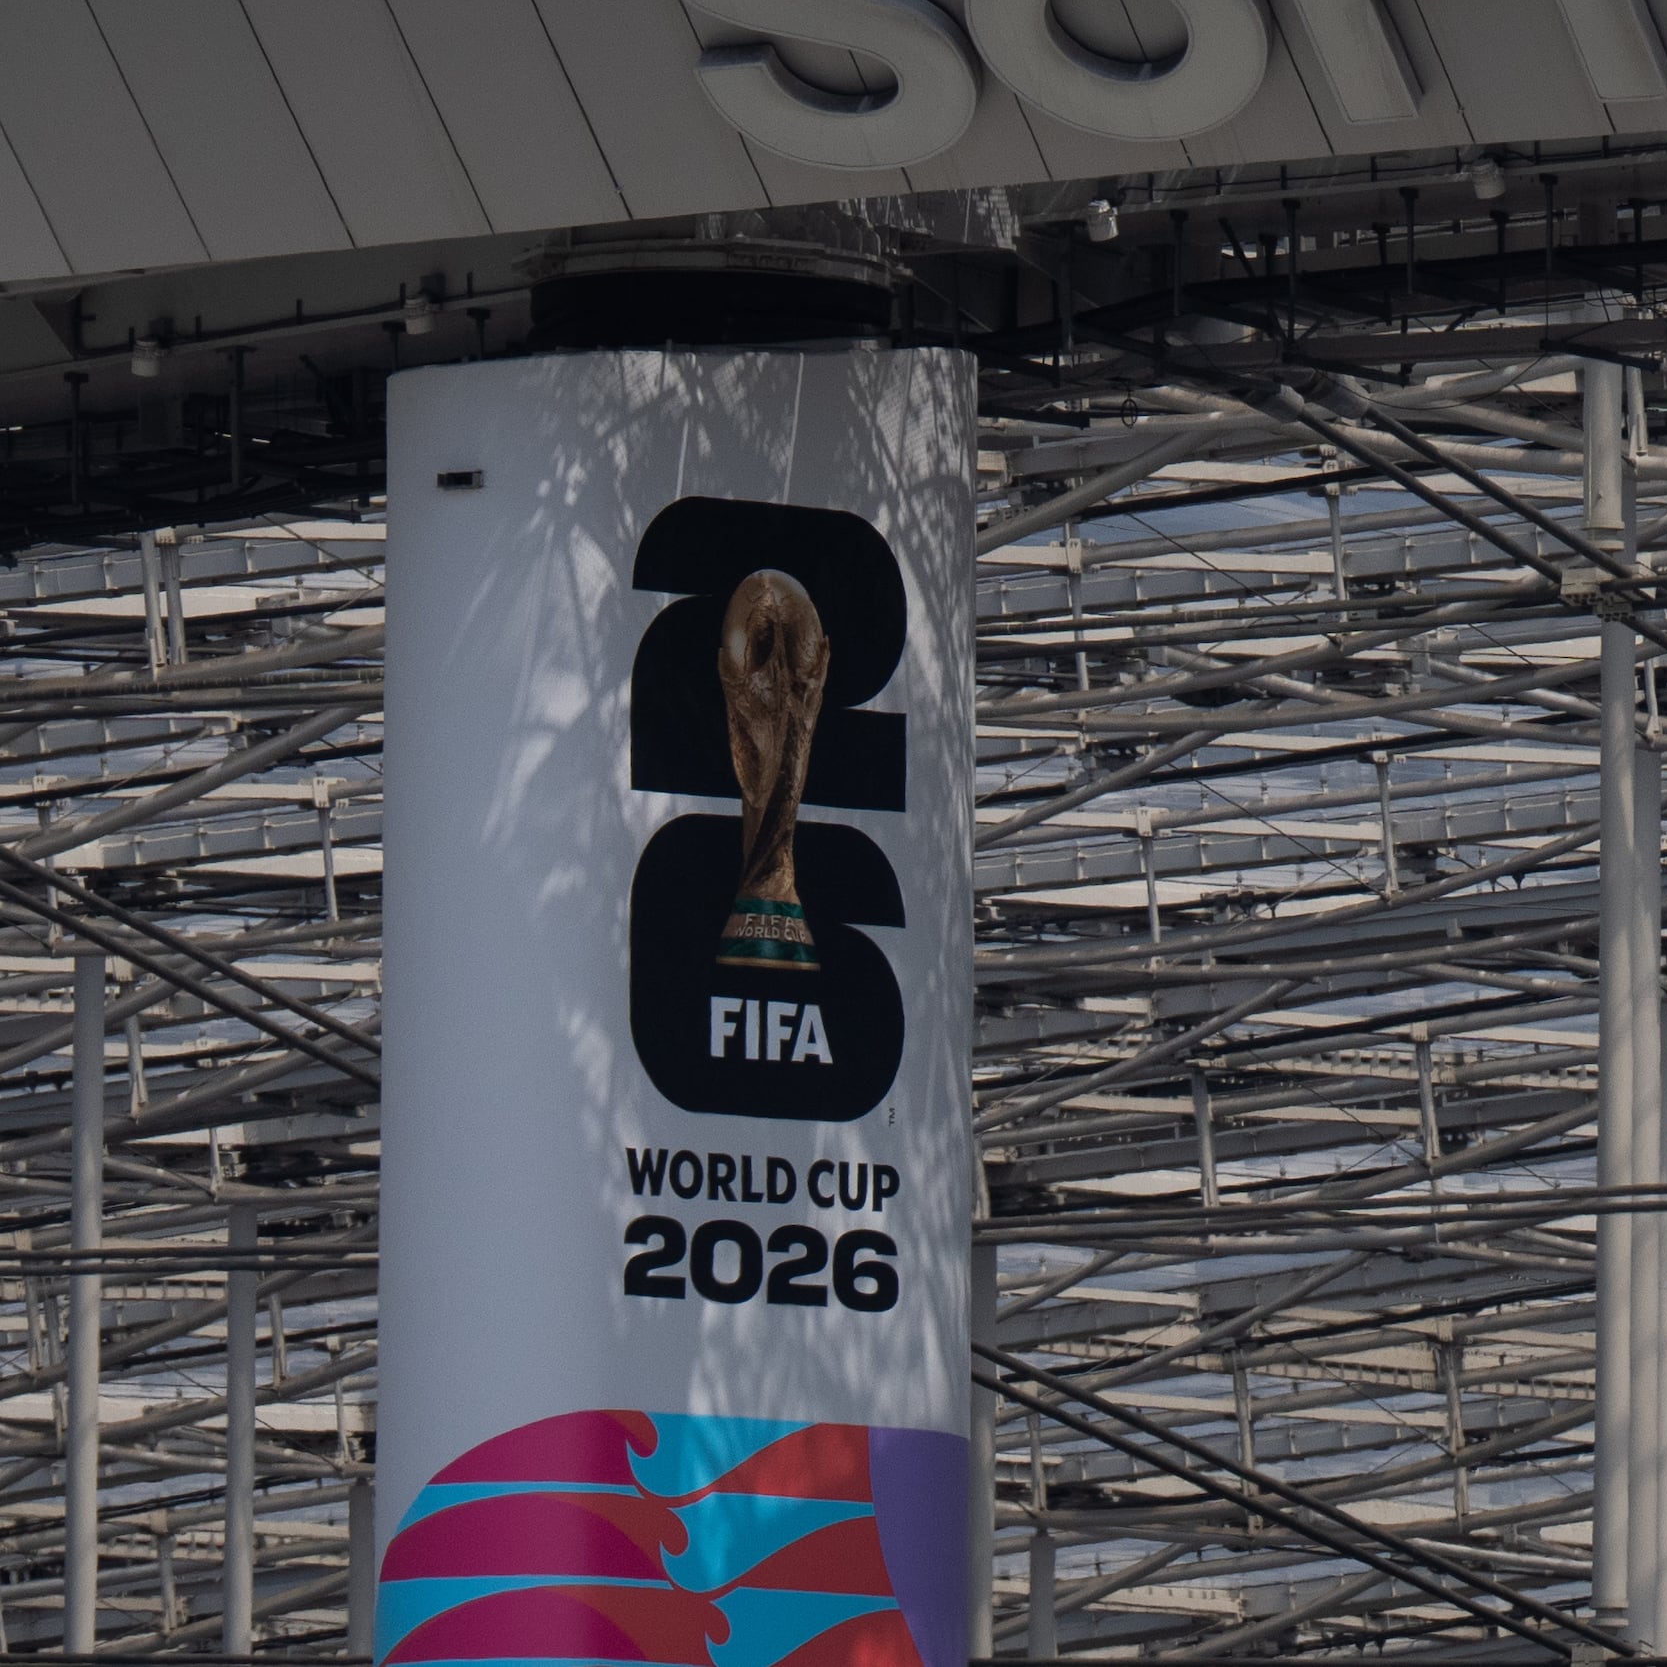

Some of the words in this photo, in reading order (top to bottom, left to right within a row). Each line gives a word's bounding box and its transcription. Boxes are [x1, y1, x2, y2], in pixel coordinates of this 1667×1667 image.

[745, 913, 795, 927] FIFA
[710, 995, 833, 1064] FIFA
[625, 1147, 797, 1204] WORLD
[807, 1158, 900, 1212] CUP
[623, 1214, 899, 1312] 2026
